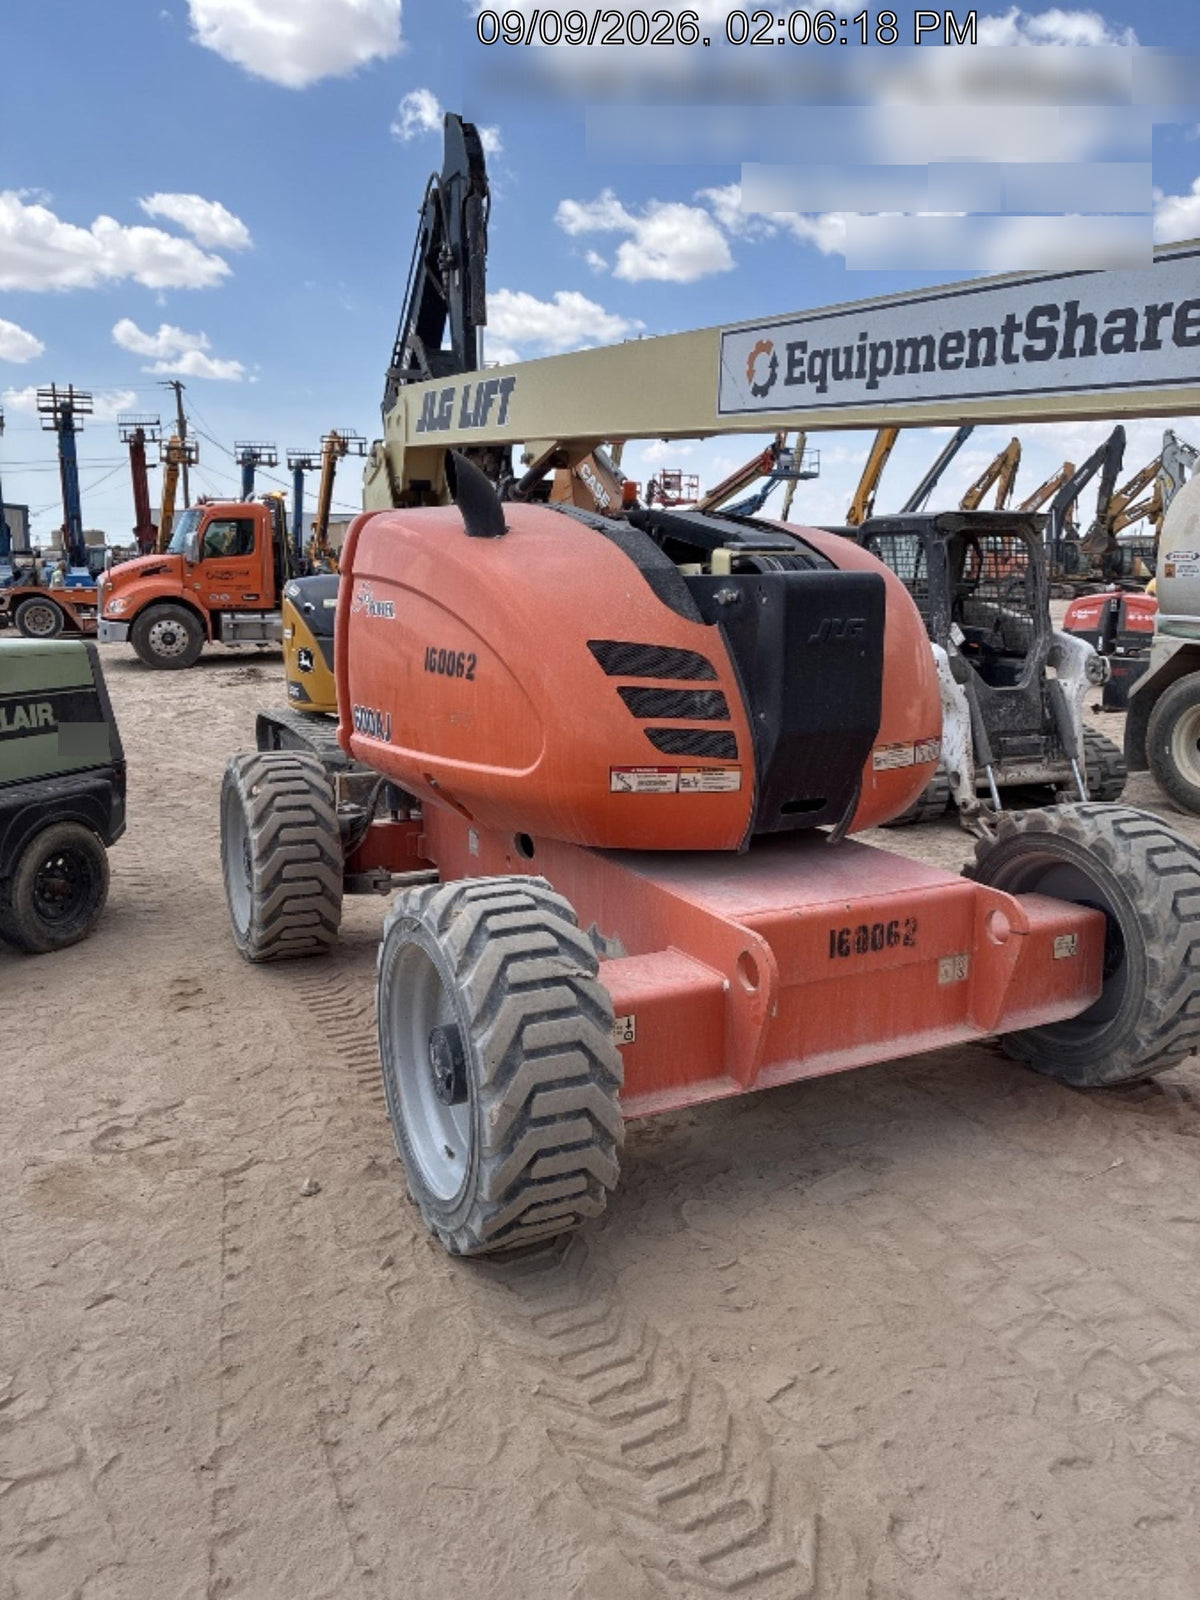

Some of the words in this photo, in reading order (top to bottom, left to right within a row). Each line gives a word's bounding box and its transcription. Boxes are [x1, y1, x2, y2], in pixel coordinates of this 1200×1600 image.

[784, 299, 1200, 394] EquipmentShare
[415, 386, 456, 432] JLG
[457, 375, 517, 429] LIFT
[424, 646, 478, 682] 160062
[353, 704, 392, 743] 600AJ
[829, 917, 918, 959] 160062
